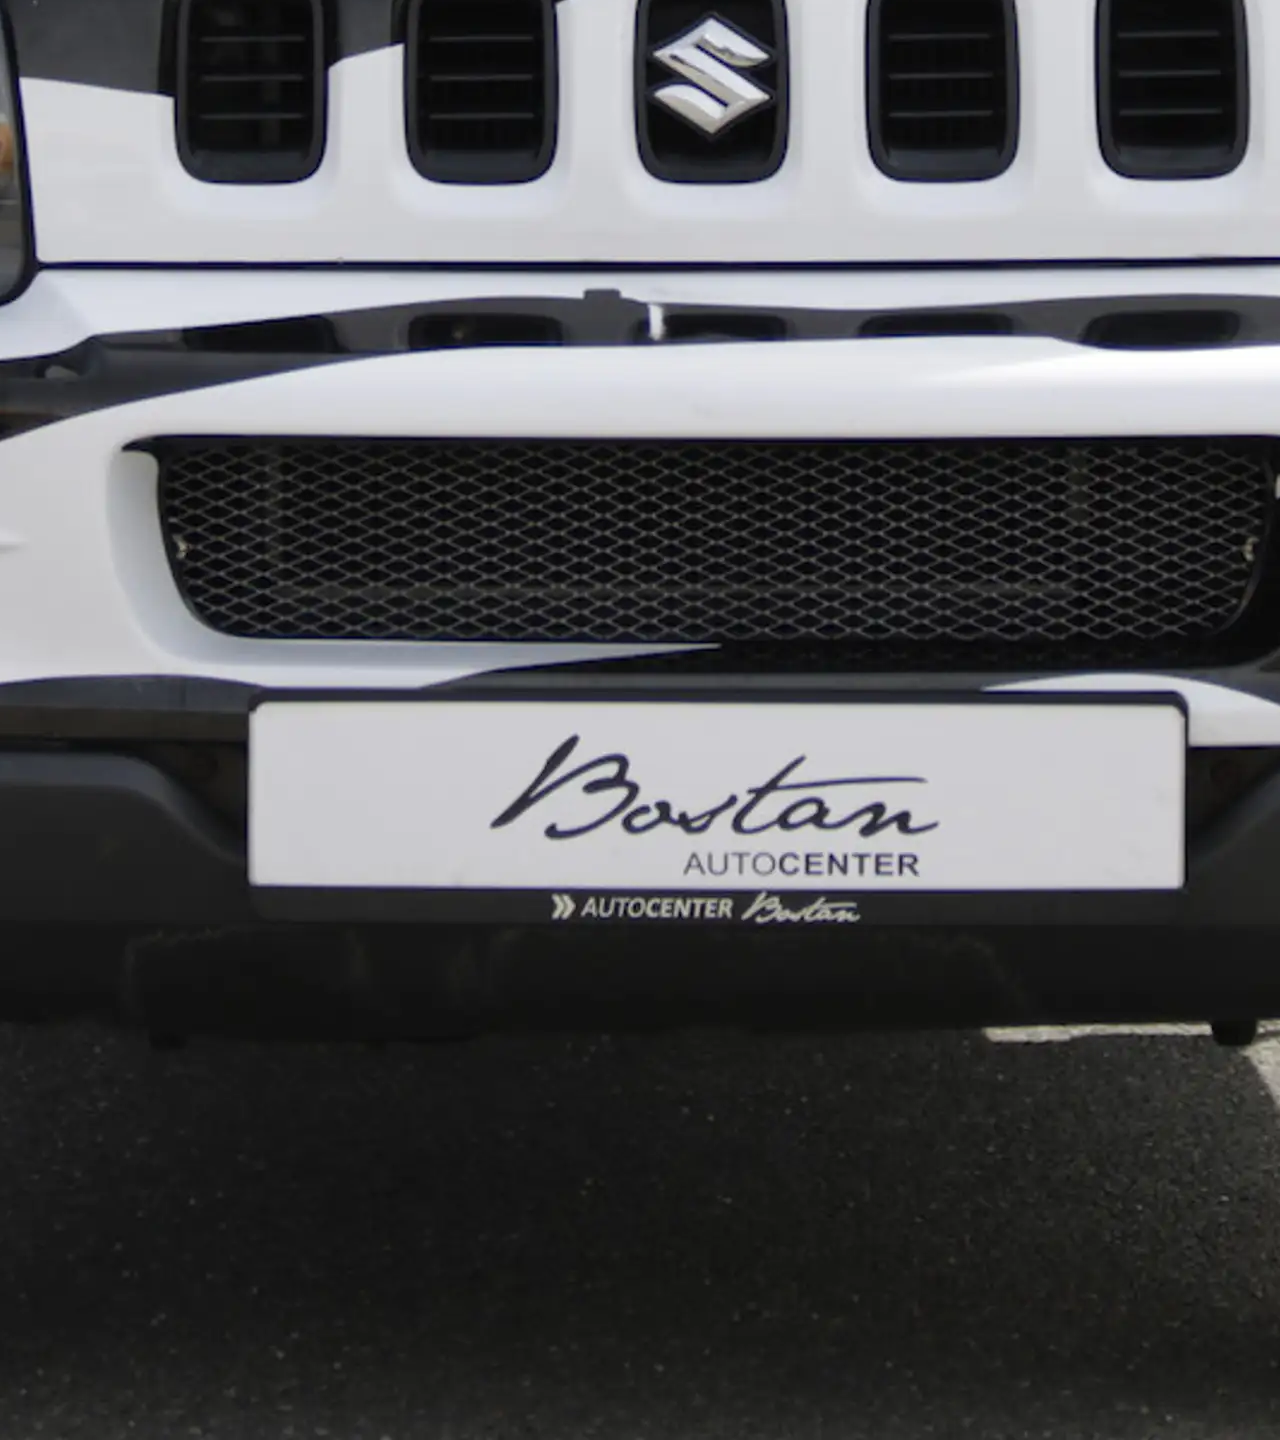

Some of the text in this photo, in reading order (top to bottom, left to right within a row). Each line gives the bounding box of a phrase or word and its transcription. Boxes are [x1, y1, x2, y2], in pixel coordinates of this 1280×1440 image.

[489, 733, 939, 842] Bostan
[682, 852, 920, 878] AUTOCENTER
[579, 891, 862, 924] AUTOCENTER Bostan
